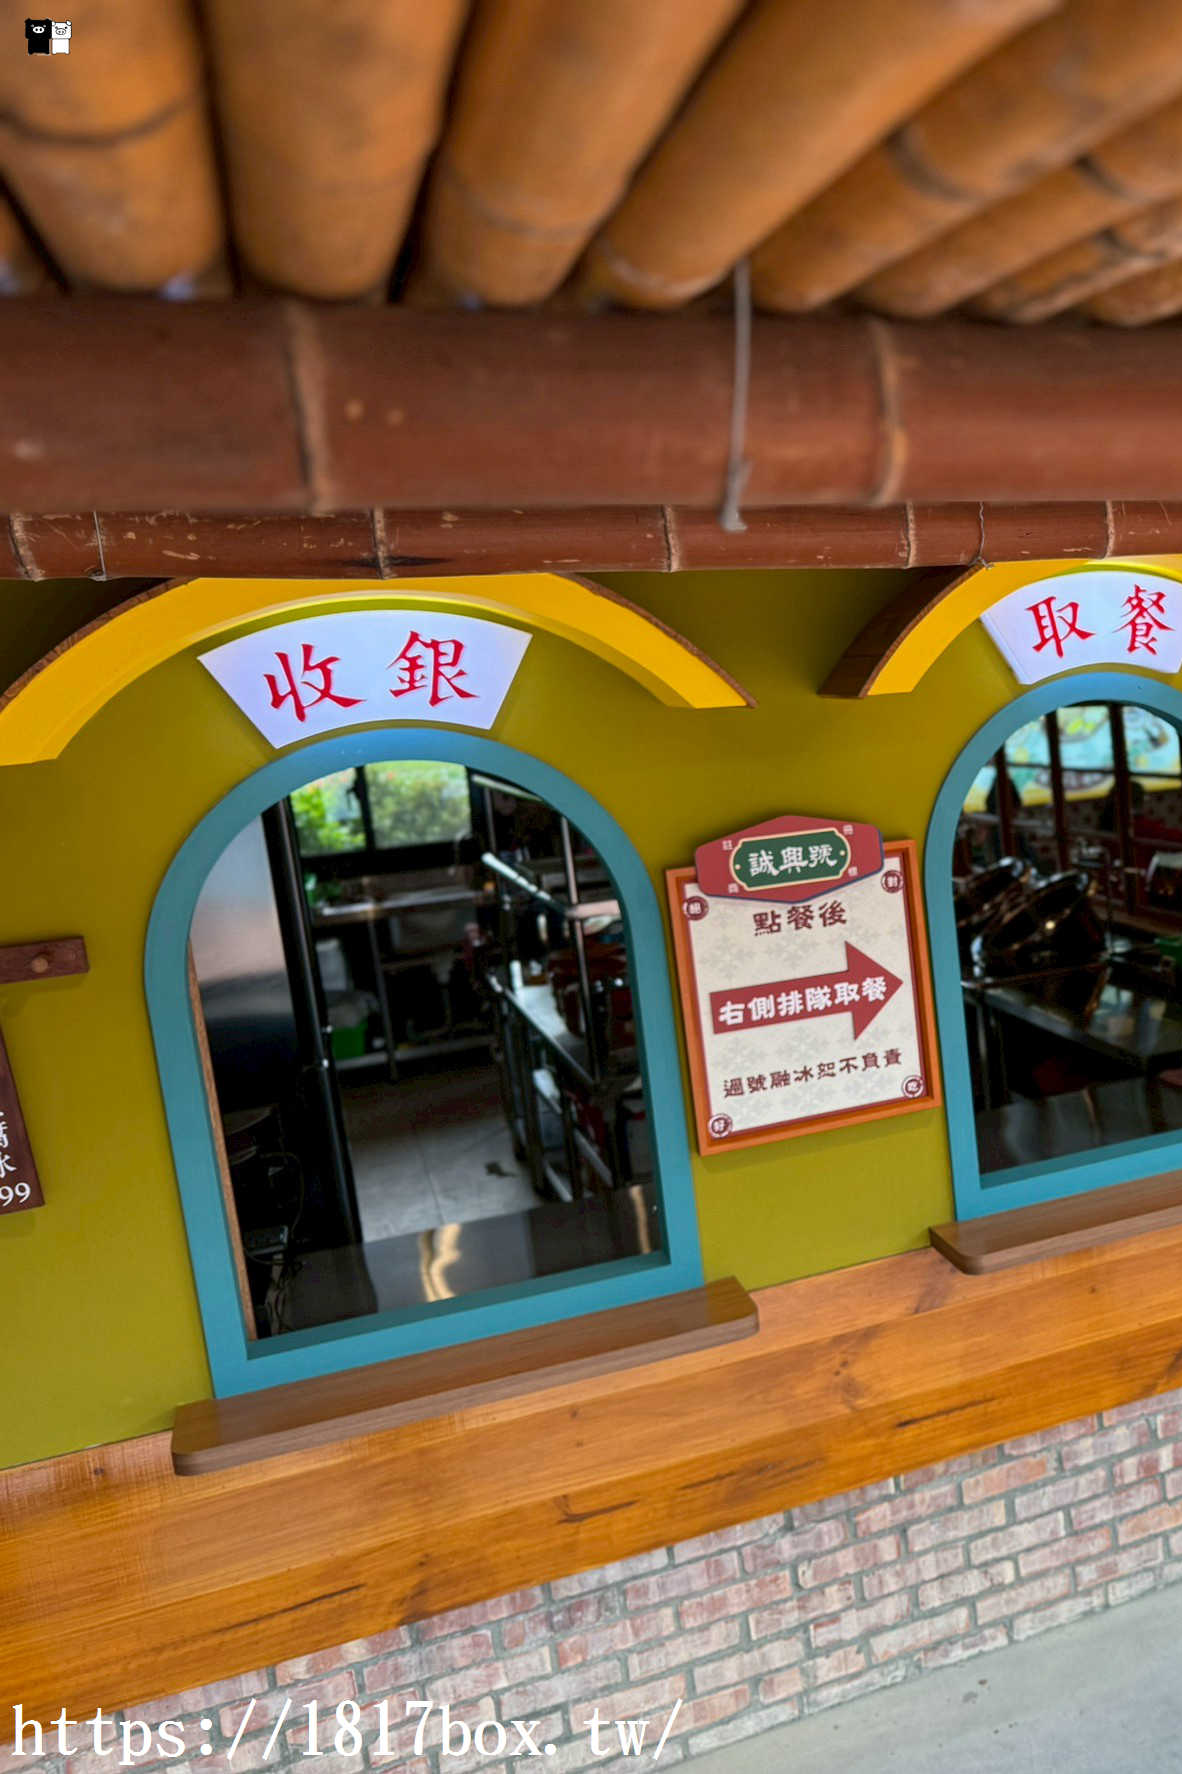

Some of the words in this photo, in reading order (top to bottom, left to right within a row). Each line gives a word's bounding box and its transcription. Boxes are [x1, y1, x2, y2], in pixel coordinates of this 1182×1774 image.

[1024, 584, 1177, 659] 取餐
[262, 630, 480, 723] 收銀
[747, 843, 838, 878] 誠興號
[752, 900, 848, 937] 點餐後
[718, 975, 888, 1027] 右側排隊取餐
[723, 1048, 903, 1099] 過號融冰恕不負責
